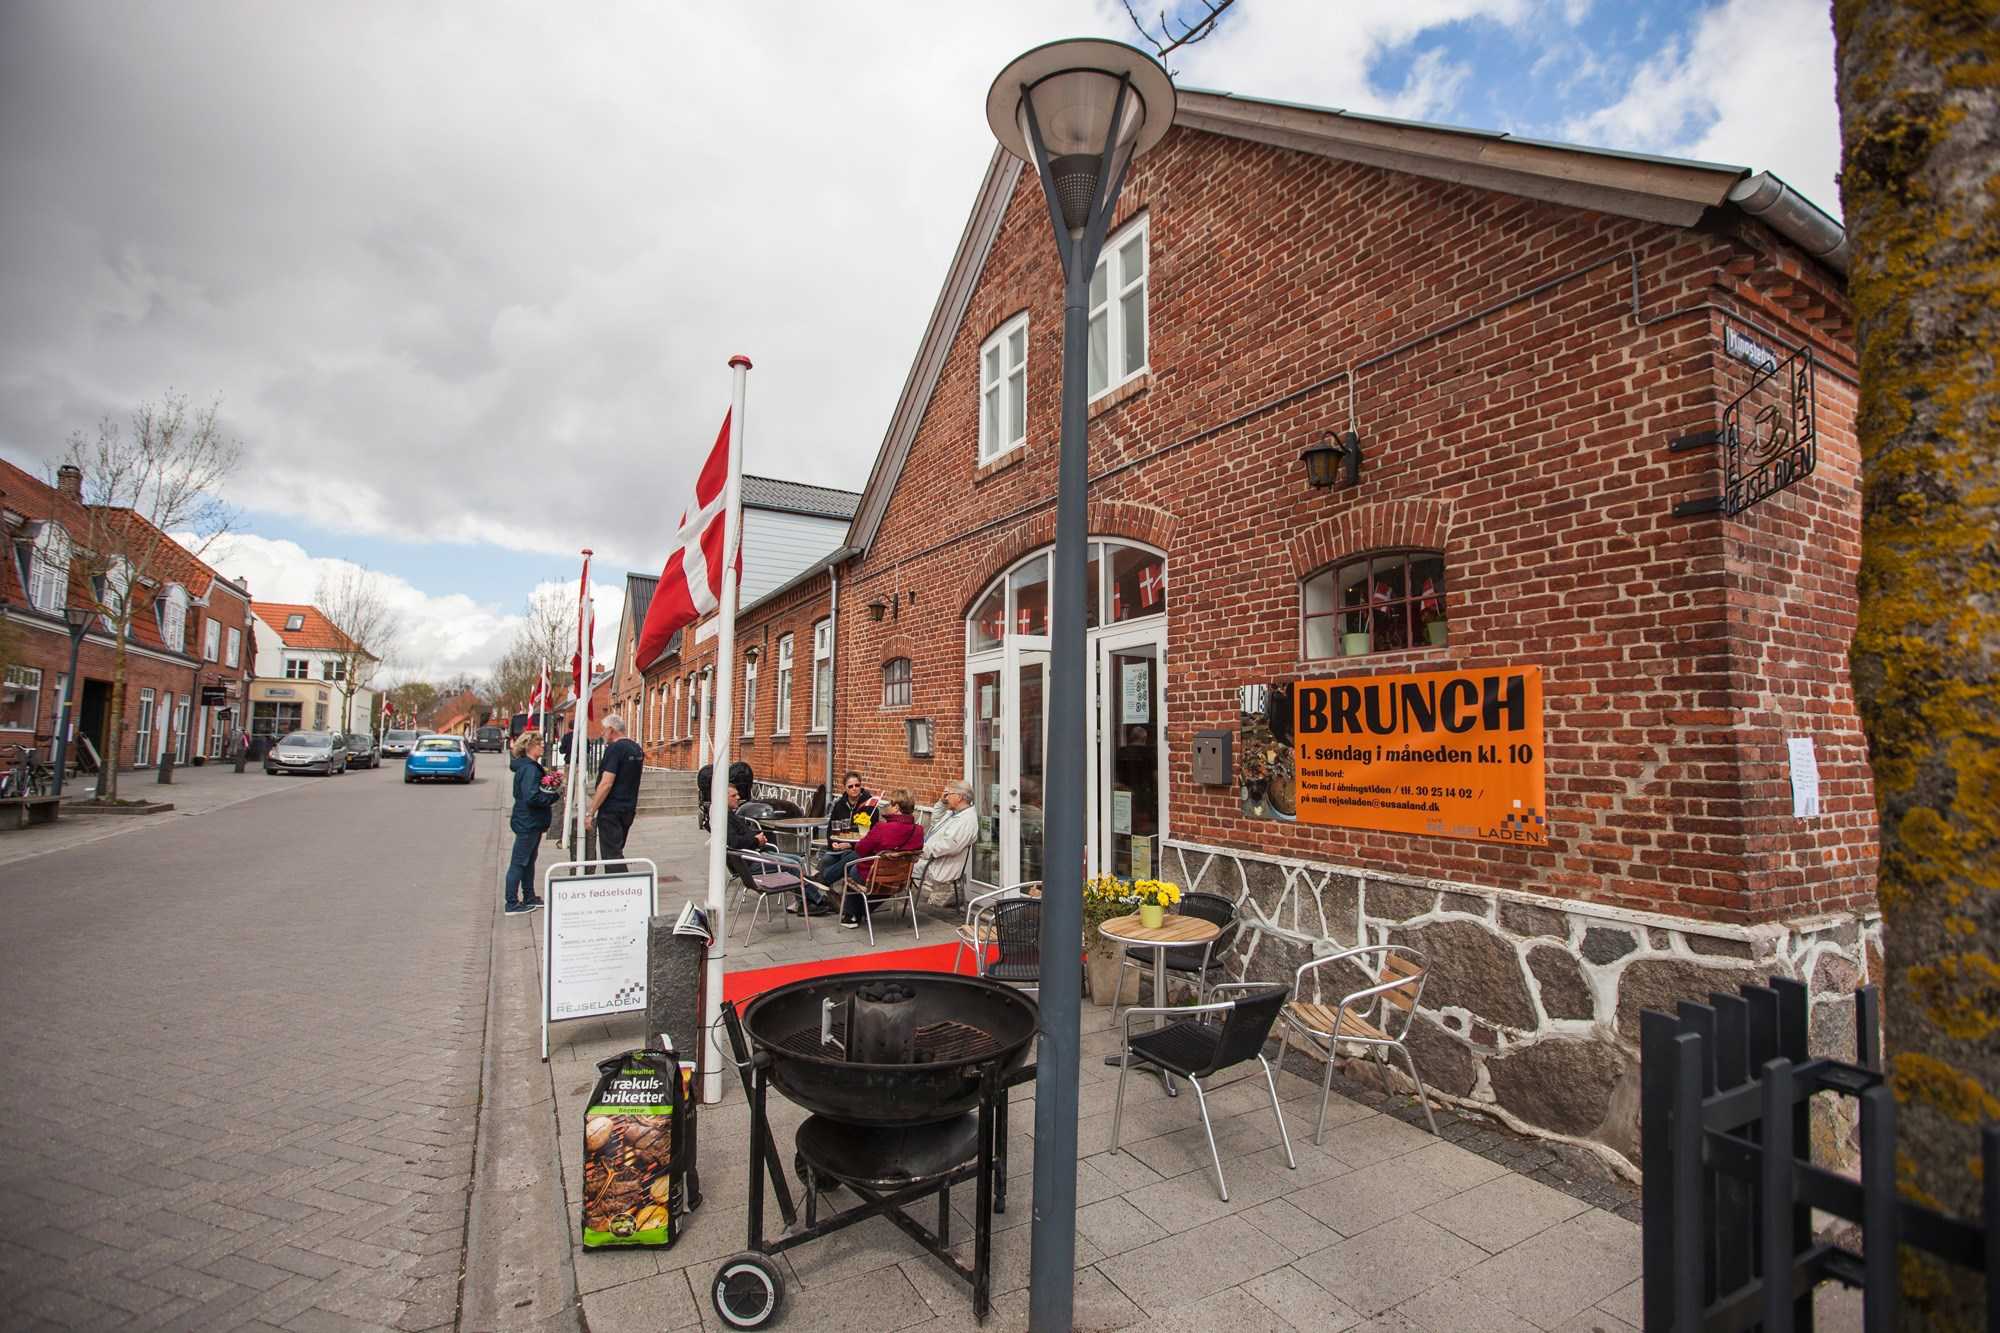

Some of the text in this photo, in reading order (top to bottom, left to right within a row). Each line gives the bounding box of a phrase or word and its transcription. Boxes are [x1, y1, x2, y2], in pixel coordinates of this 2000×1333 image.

[1299, 674, 1525, 735] BRUNCH
[1301, 742, 1533, 765] 1. søndag i måneden kl. 10
[1301, 768, 1345, 778] Bestil bord:
[1301, 781, 1319, 790] Kom
[1319, 782, 1331, 791] ind
[1332, 782, 1336, 791] i
[1337, 783, 1392, 795] åbningstiden
[1401, 786, 1414, 795] tlf.
[1416, 786, 1428, 797] 30
[1431, 787, 1443, 797] 25
[1445, 788, 1456, 797] 14
[1458, 788, 1473, 799] 02
[1300, 794, 1310, 804] på
[1311, 795, 1327, 804] mail
[557, 886, 643, 902] 10 års fødselsdag
[556, 996, 641, 1014] REJSELADEN
[601, 1090, 665, 1105] briketter
